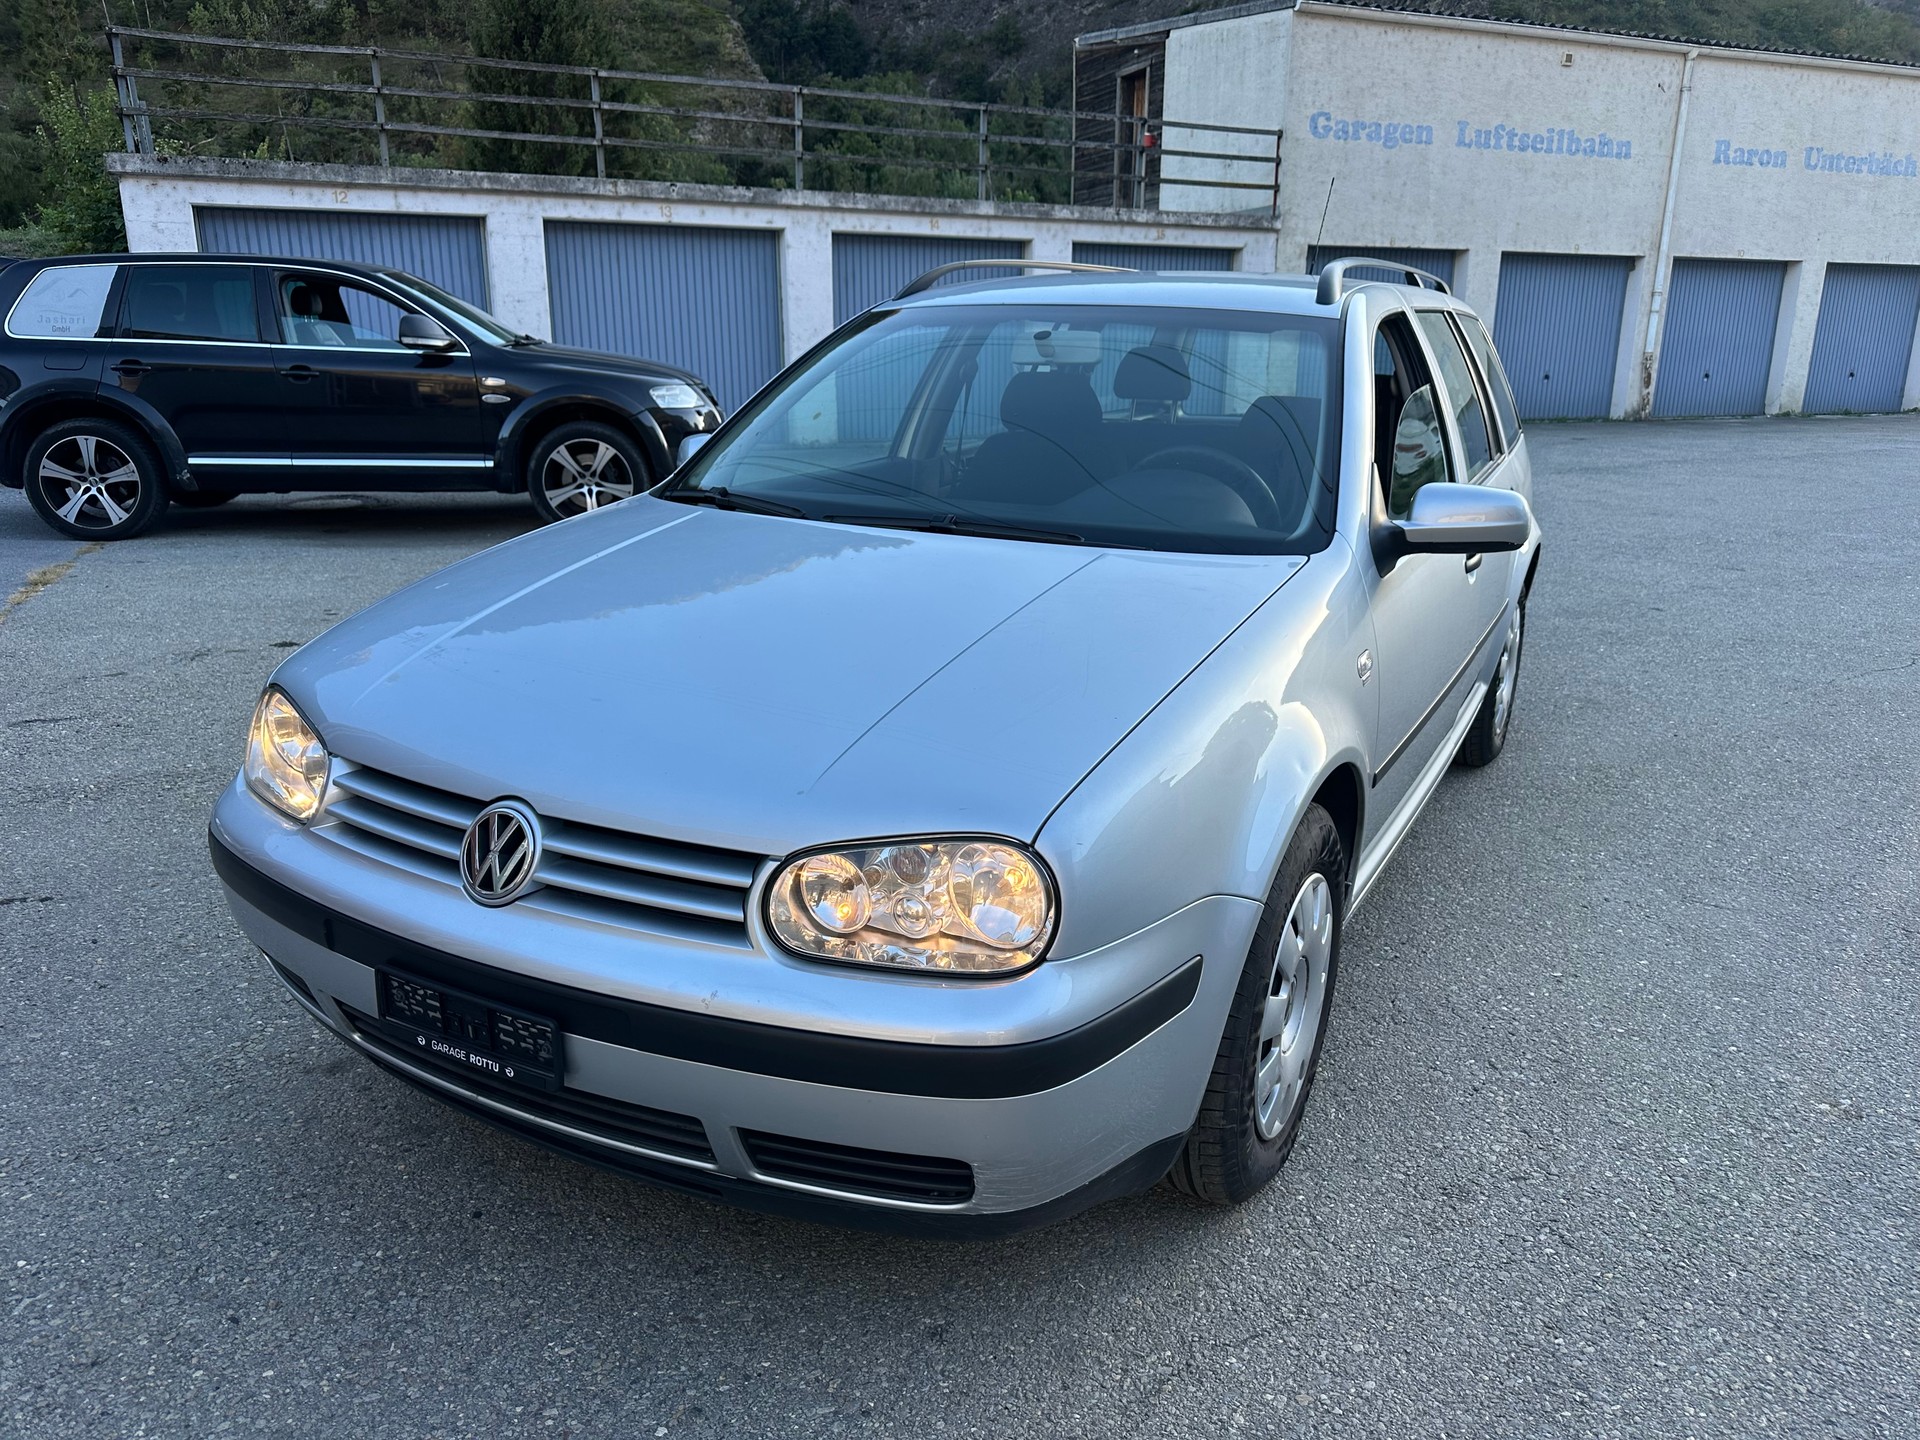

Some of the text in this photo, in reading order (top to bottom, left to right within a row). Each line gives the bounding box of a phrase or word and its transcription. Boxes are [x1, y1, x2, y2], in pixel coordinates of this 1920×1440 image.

[1308, 111, 1918, 177] Garagen Luftseilbahn Raron Unterbäch
[331, 190, 349, 204] 12
[658, 204, 672, 218] 13
[51, 324, 71, 333] GmbH
[464, 807, 535, 900] VW
[431, 1039, 500, 1073] GARAGE ROTTU
